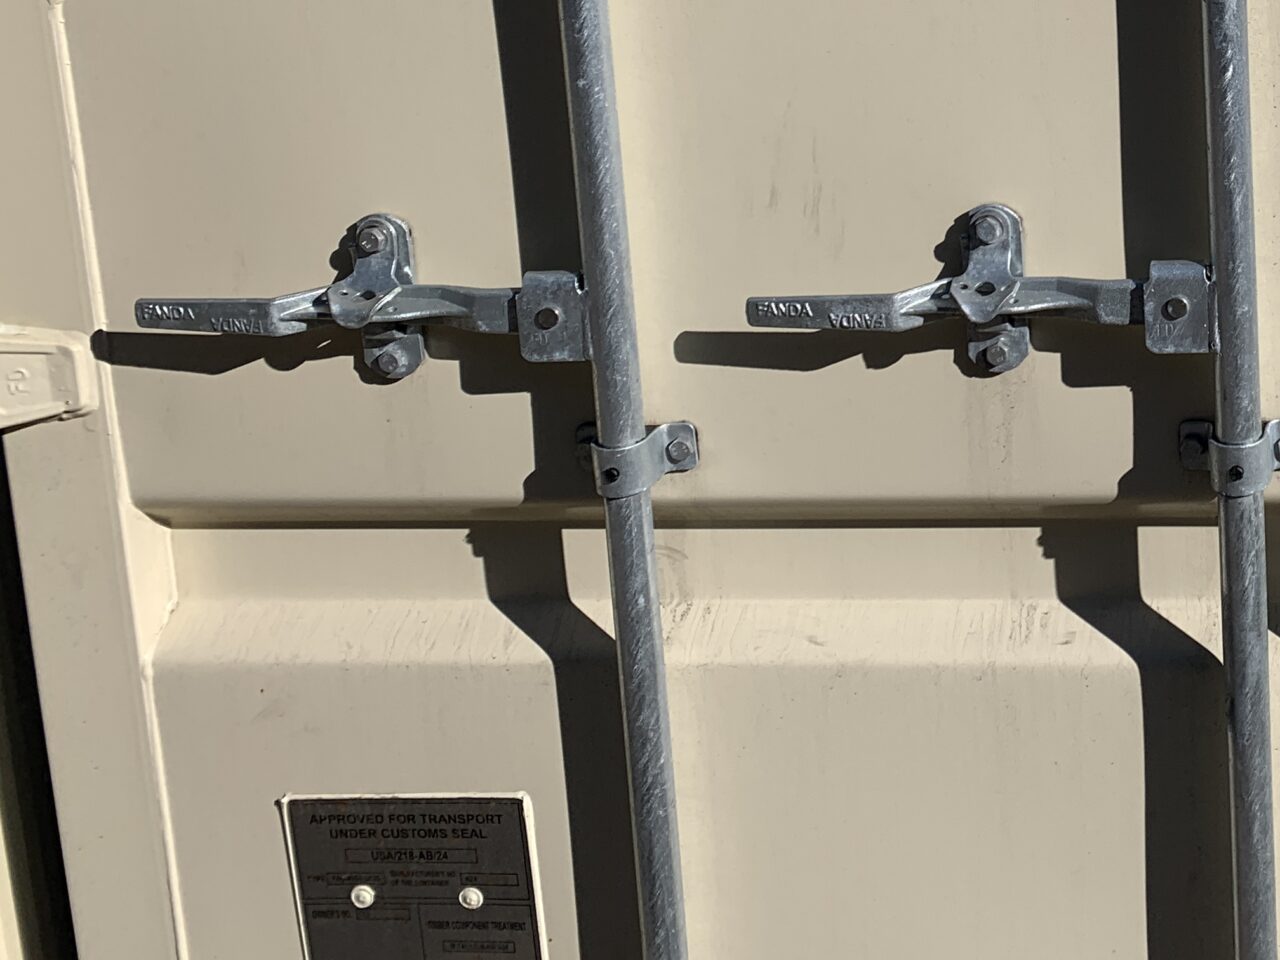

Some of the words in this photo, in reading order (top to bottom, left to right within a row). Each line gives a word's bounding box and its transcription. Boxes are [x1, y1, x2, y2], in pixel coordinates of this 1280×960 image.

[142, 303, 196, 321] FANDA
[755, 301, 814, 318] FANDA
[828, 313, 887, 329] FANDA
[309, 813, 384, 825] APPROVED
[389, 814, 418, 825] FOR
[419, 813, 503, 825] TRANSPORT
[330, 828, 378, 839] UNDER
[381, 828, 448, 839] CUSTOMS
[452, 828, 488, 839] SEAL
